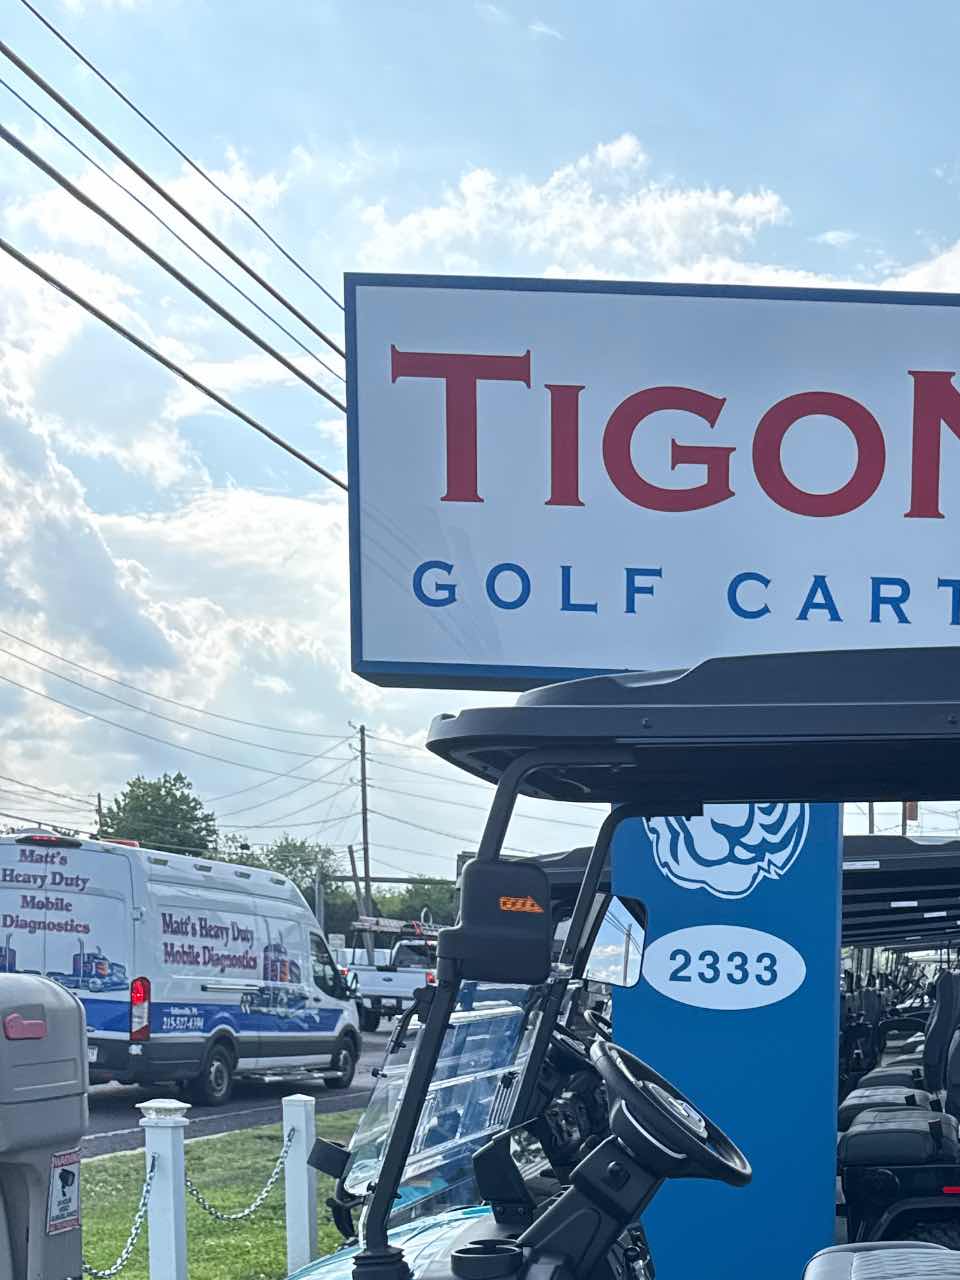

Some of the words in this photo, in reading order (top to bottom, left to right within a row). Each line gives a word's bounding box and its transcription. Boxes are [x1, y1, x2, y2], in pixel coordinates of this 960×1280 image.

[412, 560, 663, 614] GOLF
[19, 848, 68, 866] Matt's
[1, 867, 48, 889] Heavy
[50, 871, 90, 892] Duty
[20, 895, 73, 912] Mobile
[2, 914, 90, 934] Diagnostics
[161, 912, 197, 938] Matt's
[198, 916, 230, 948] Heavy
[231, 920, 254, 951] Duty
[163, 942, 201, 966] Mobile
[202, 945, 257, 973] Diagnostics
[669, 948, 778, 986] 2333
